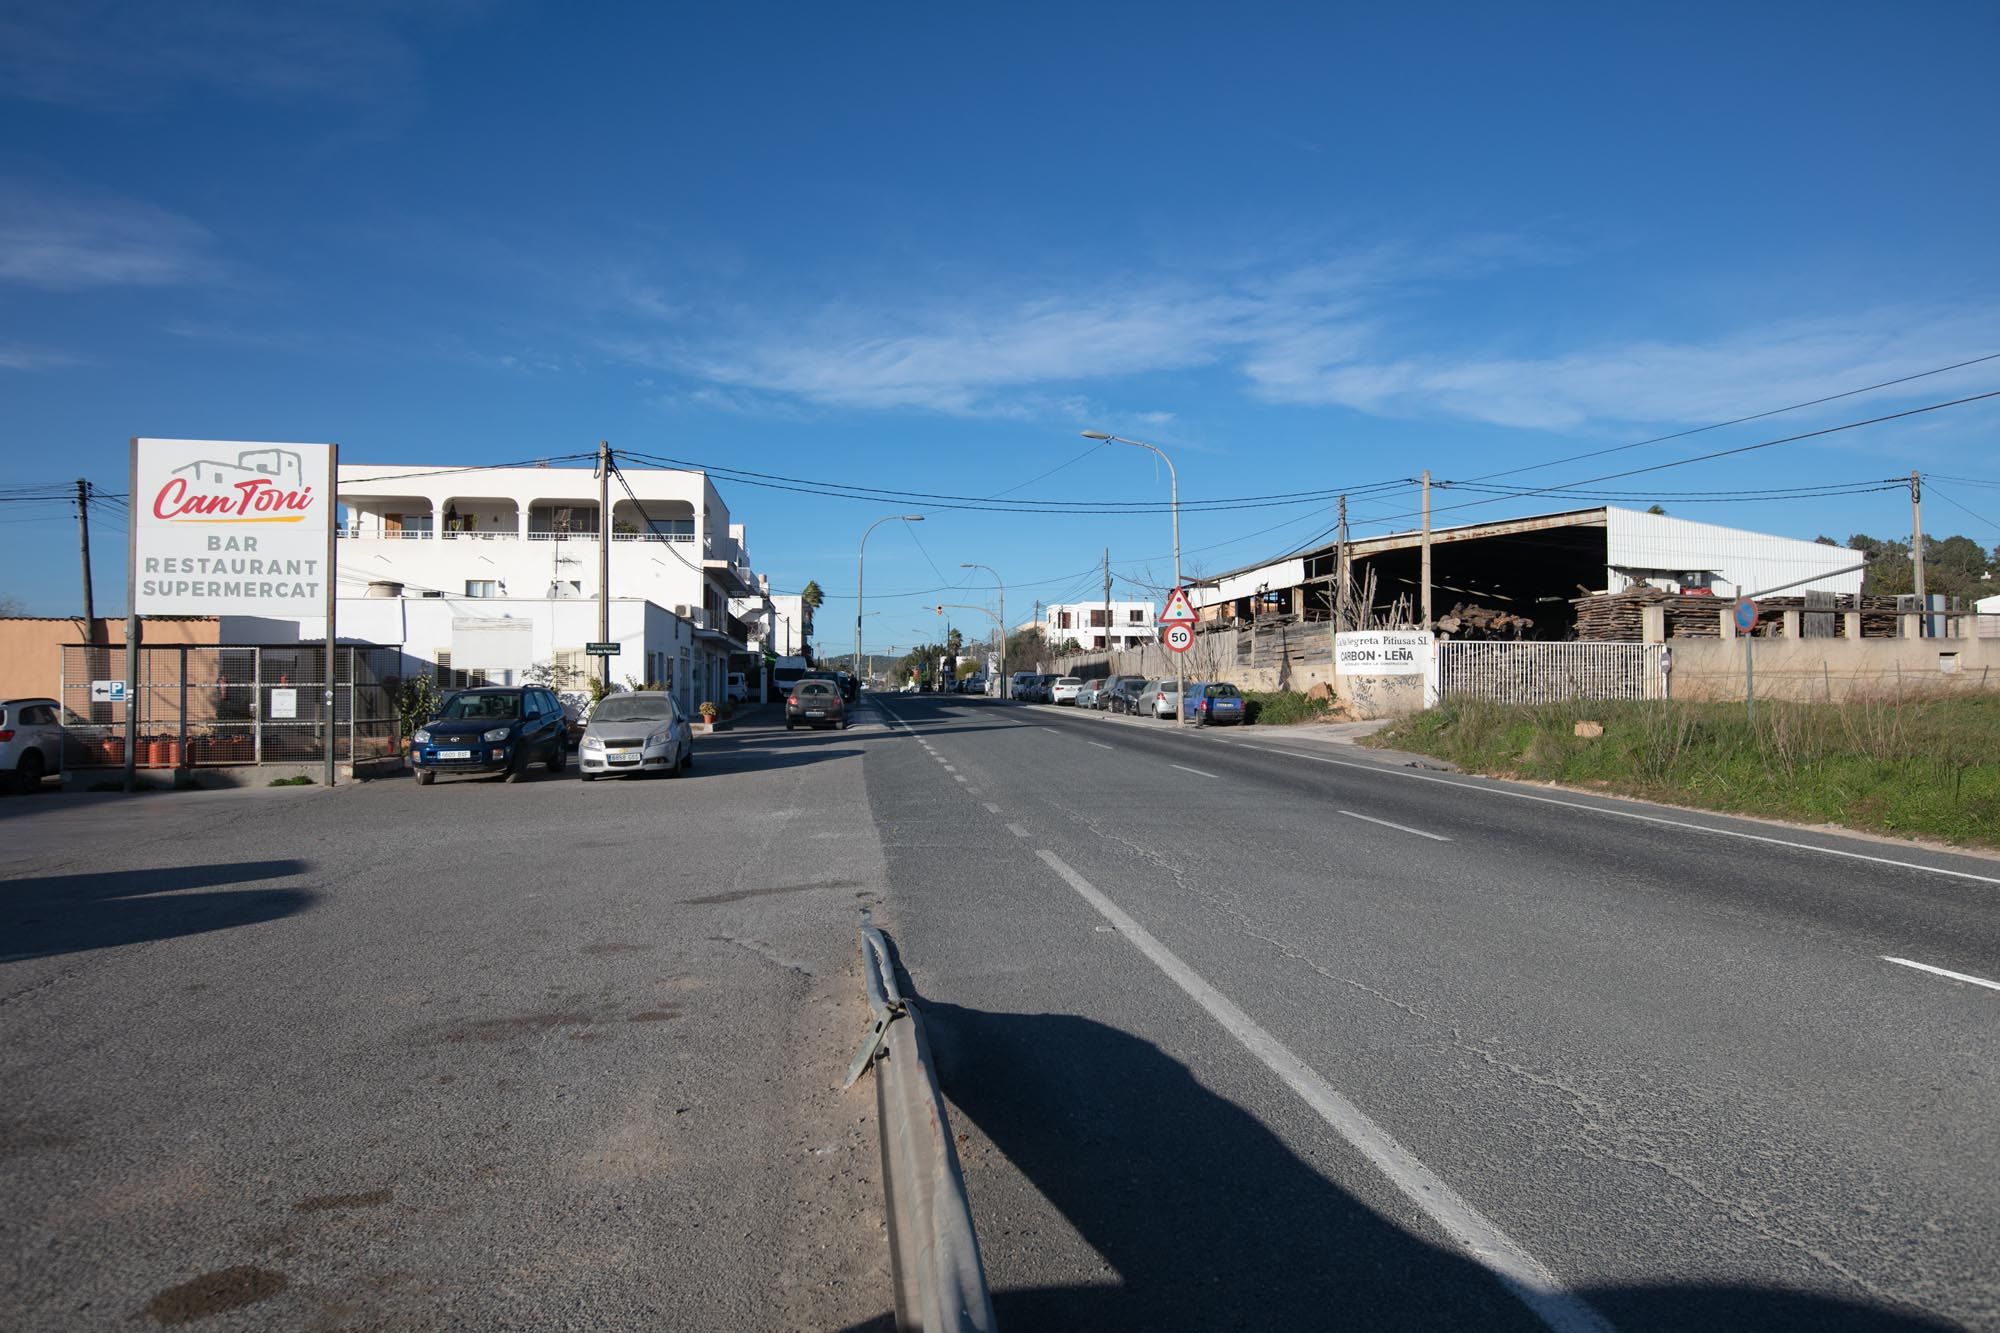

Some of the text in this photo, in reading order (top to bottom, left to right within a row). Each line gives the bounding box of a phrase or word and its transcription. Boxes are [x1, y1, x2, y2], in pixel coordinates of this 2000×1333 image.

[234, 478, 314, 516] Toni
[207, 535, 258, 552] BAR
[145, 557, 318, 576] RESTAURANT
[143, 580, 319, 598] SUPERMERCAT
[1171, 633, 1187, 642] 50
[1383, 635, 1416, 645] Pitiusas
[1340, 648, 1414, 661] CARBON LEÑA
[112, 682, 122, 693] P
